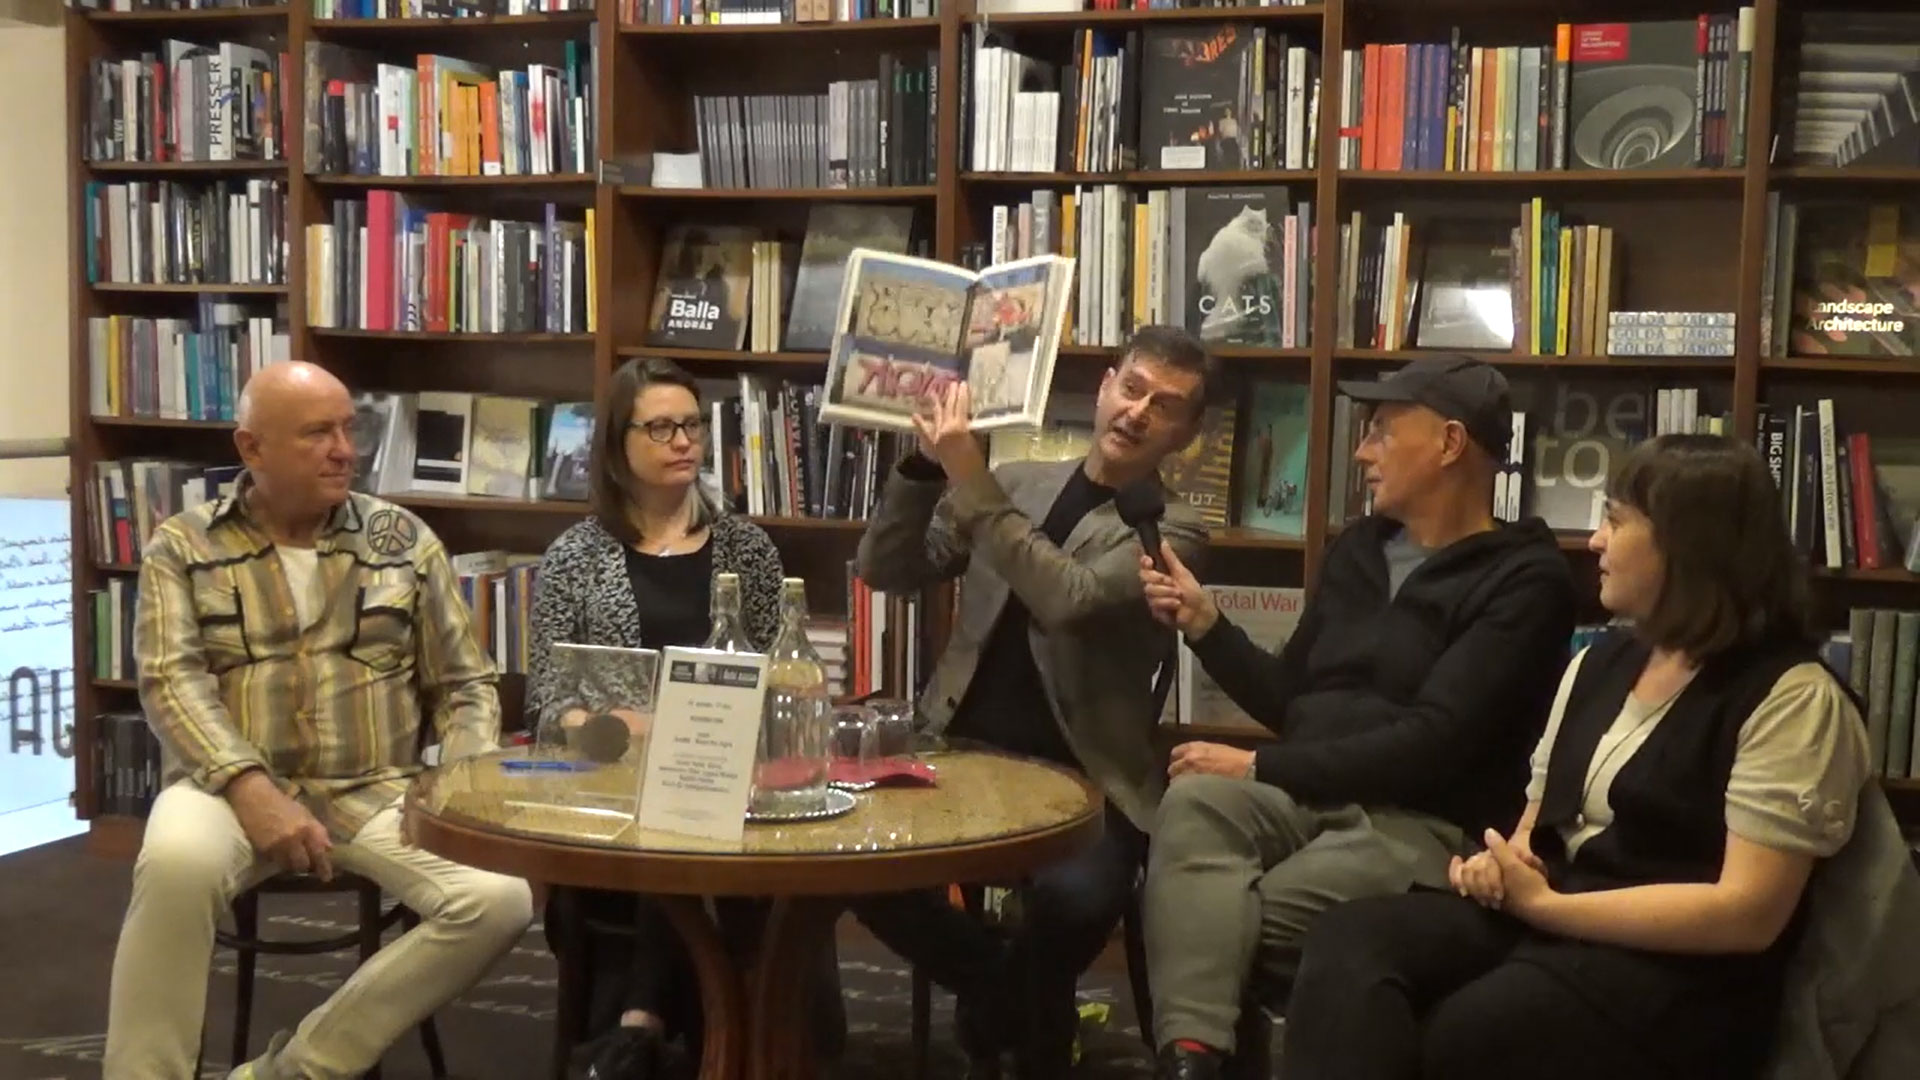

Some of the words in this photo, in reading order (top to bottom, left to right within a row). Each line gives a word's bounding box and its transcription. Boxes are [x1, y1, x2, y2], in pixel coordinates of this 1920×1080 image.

[209, 62, 221, 145] PRESSER
[670, 299, 720, 319] Balla
[1198, 295, 1271, 315] CATS
[1807, 316, 1904, 332] Architecture
[1554, 383, 1645, 440] be
[1770, 432, 1783, 455] BIG
[1533, 431, 1610, 488] to
[1211, 590, 1257, 610] Total
[1260, 591, 1298, 613] War
